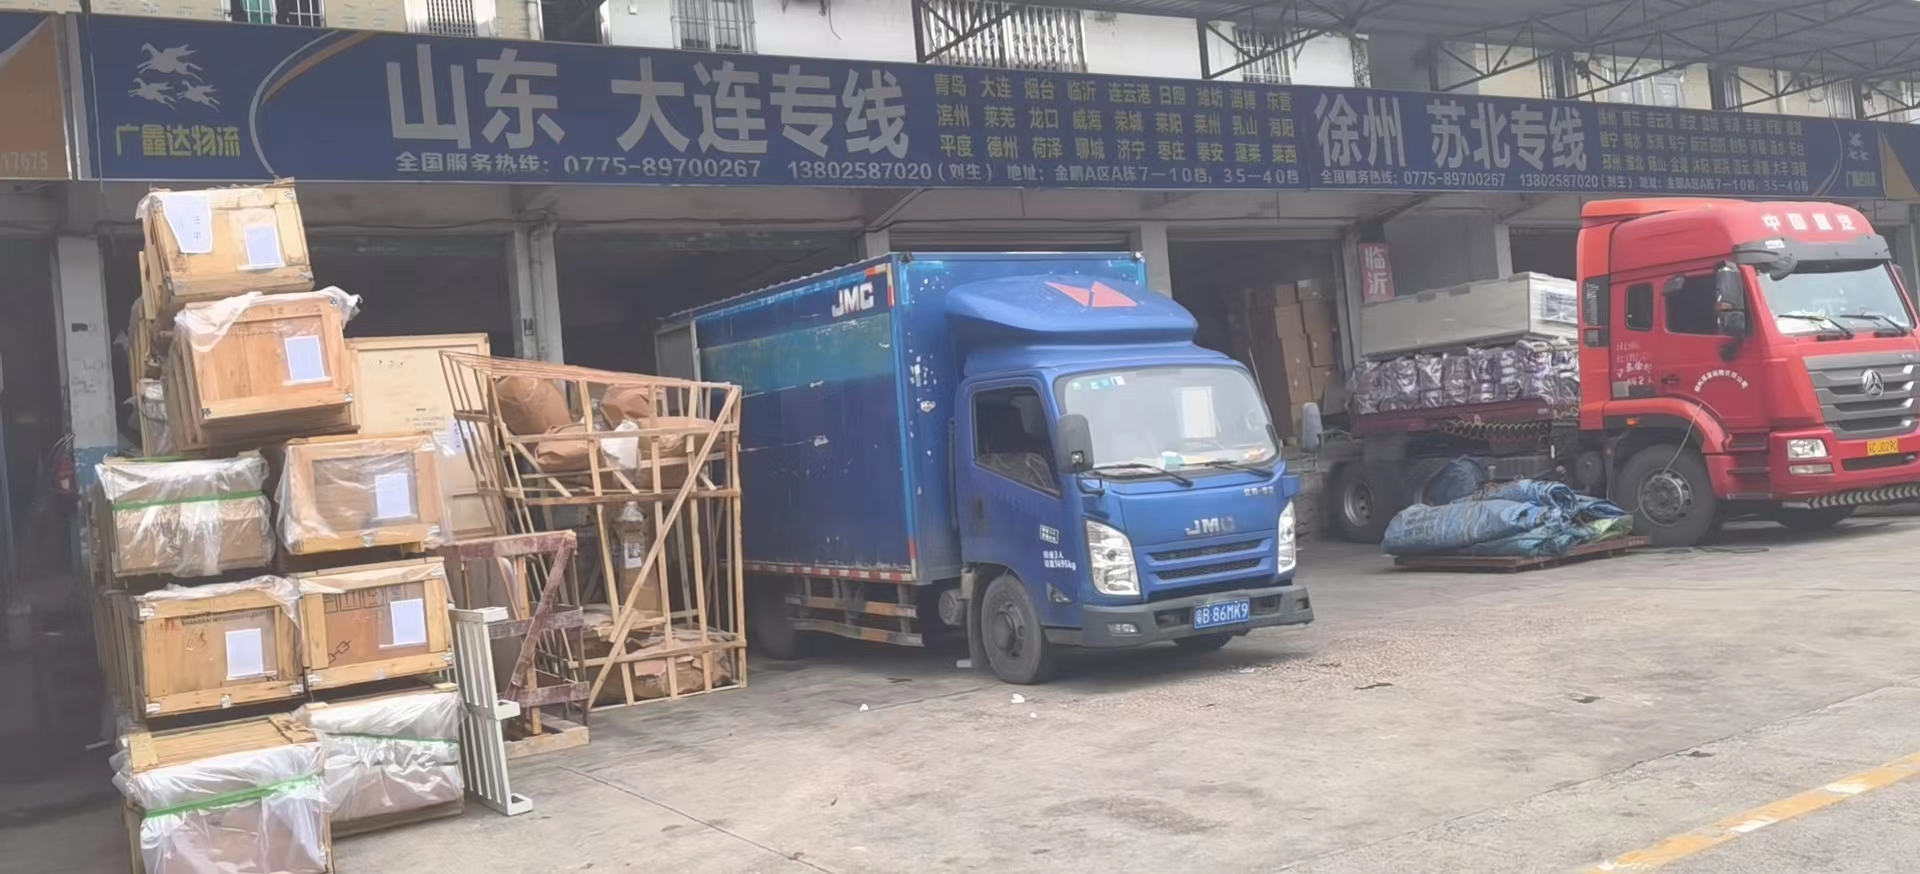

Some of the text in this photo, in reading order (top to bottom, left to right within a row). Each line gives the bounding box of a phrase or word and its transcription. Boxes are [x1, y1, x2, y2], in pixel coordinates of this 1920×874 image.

[386, 43, 910, 160] 山东 大连专线
[934, 73, 967, 98] 青岛
[980, 75, 1013, 99] 大连
[1024, 77, 1055, 100] 烟台
[1067, 79, 1097, 102] 临沂
[1108, 81, 1152, 105] 连云港
[1159, 85, 1187, 106] 日照
[937, 103, 971, 129] 滨州
[984, 105, 1016, 129] 莱芜
[1029, 107, 1059, 130] 龙口
[1073, 109, 1103, 131] 威海
[1155, 112, 1184, 135] 莱阳
[1231, 115, 1258, 137] 乳山
[1314, 93, 1588, 173] 徐州 苏北专线
[116, 124, 241, 157] 广鑫达物流
[940, 133, 975, 159] 平度
[987, 135, 1019, 160] 德州
[1116, 138, 1145, 161] 济宁
[1157, 139, 1186, 162] 枣庄
[1364, 246, 1389, 296] 临沂
[832, 282, 875, 317] JMC
[1185, 514, 1236, 535] JMC
[1043, 550, 1064, 559] 3人
